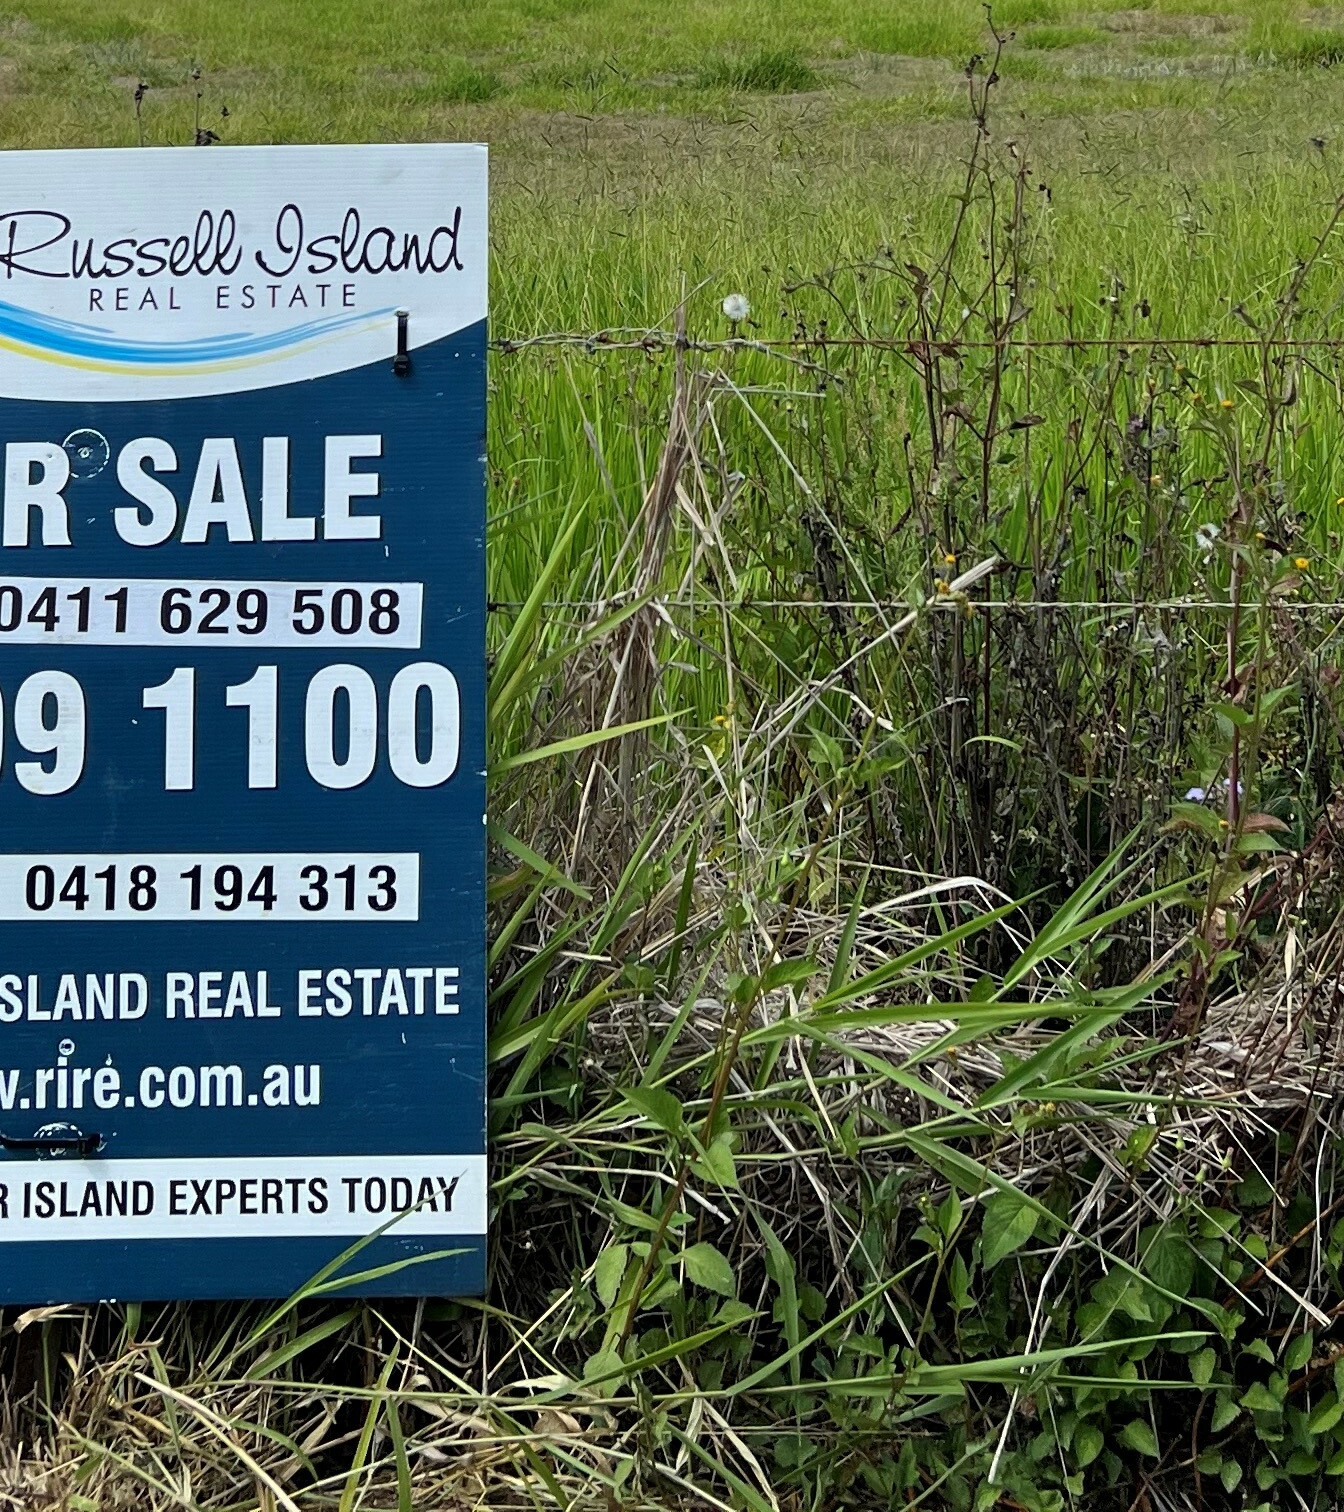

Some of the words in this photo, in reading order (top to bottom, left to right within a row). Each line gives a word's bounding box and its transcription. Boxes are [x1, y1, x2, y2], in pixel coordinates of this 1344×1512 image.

[255, 204, 463, 274] Island
[89, 288, 182, 312] REAL
[216, 285, 356, 308] ESTATE
[114, 434, 383, 546] SALE
[159, 587, 267, 635] 629
[292, 589, 400, 634] 508
[141, 662, 461, 791] 1100
[25, 863, 157, 912] 0418
[180, 864, 277, 911] 194
[299, 864, 397, 911] 313
[167, 971, 280, 1019] REAL
[298, 968, 460, 1016] ESTATE
[23, 1180, 153, 1219] ISLAND
[169, 1178, 328, 1216] EXPERTS
[346, 1176, 460, 1213] TODAY
